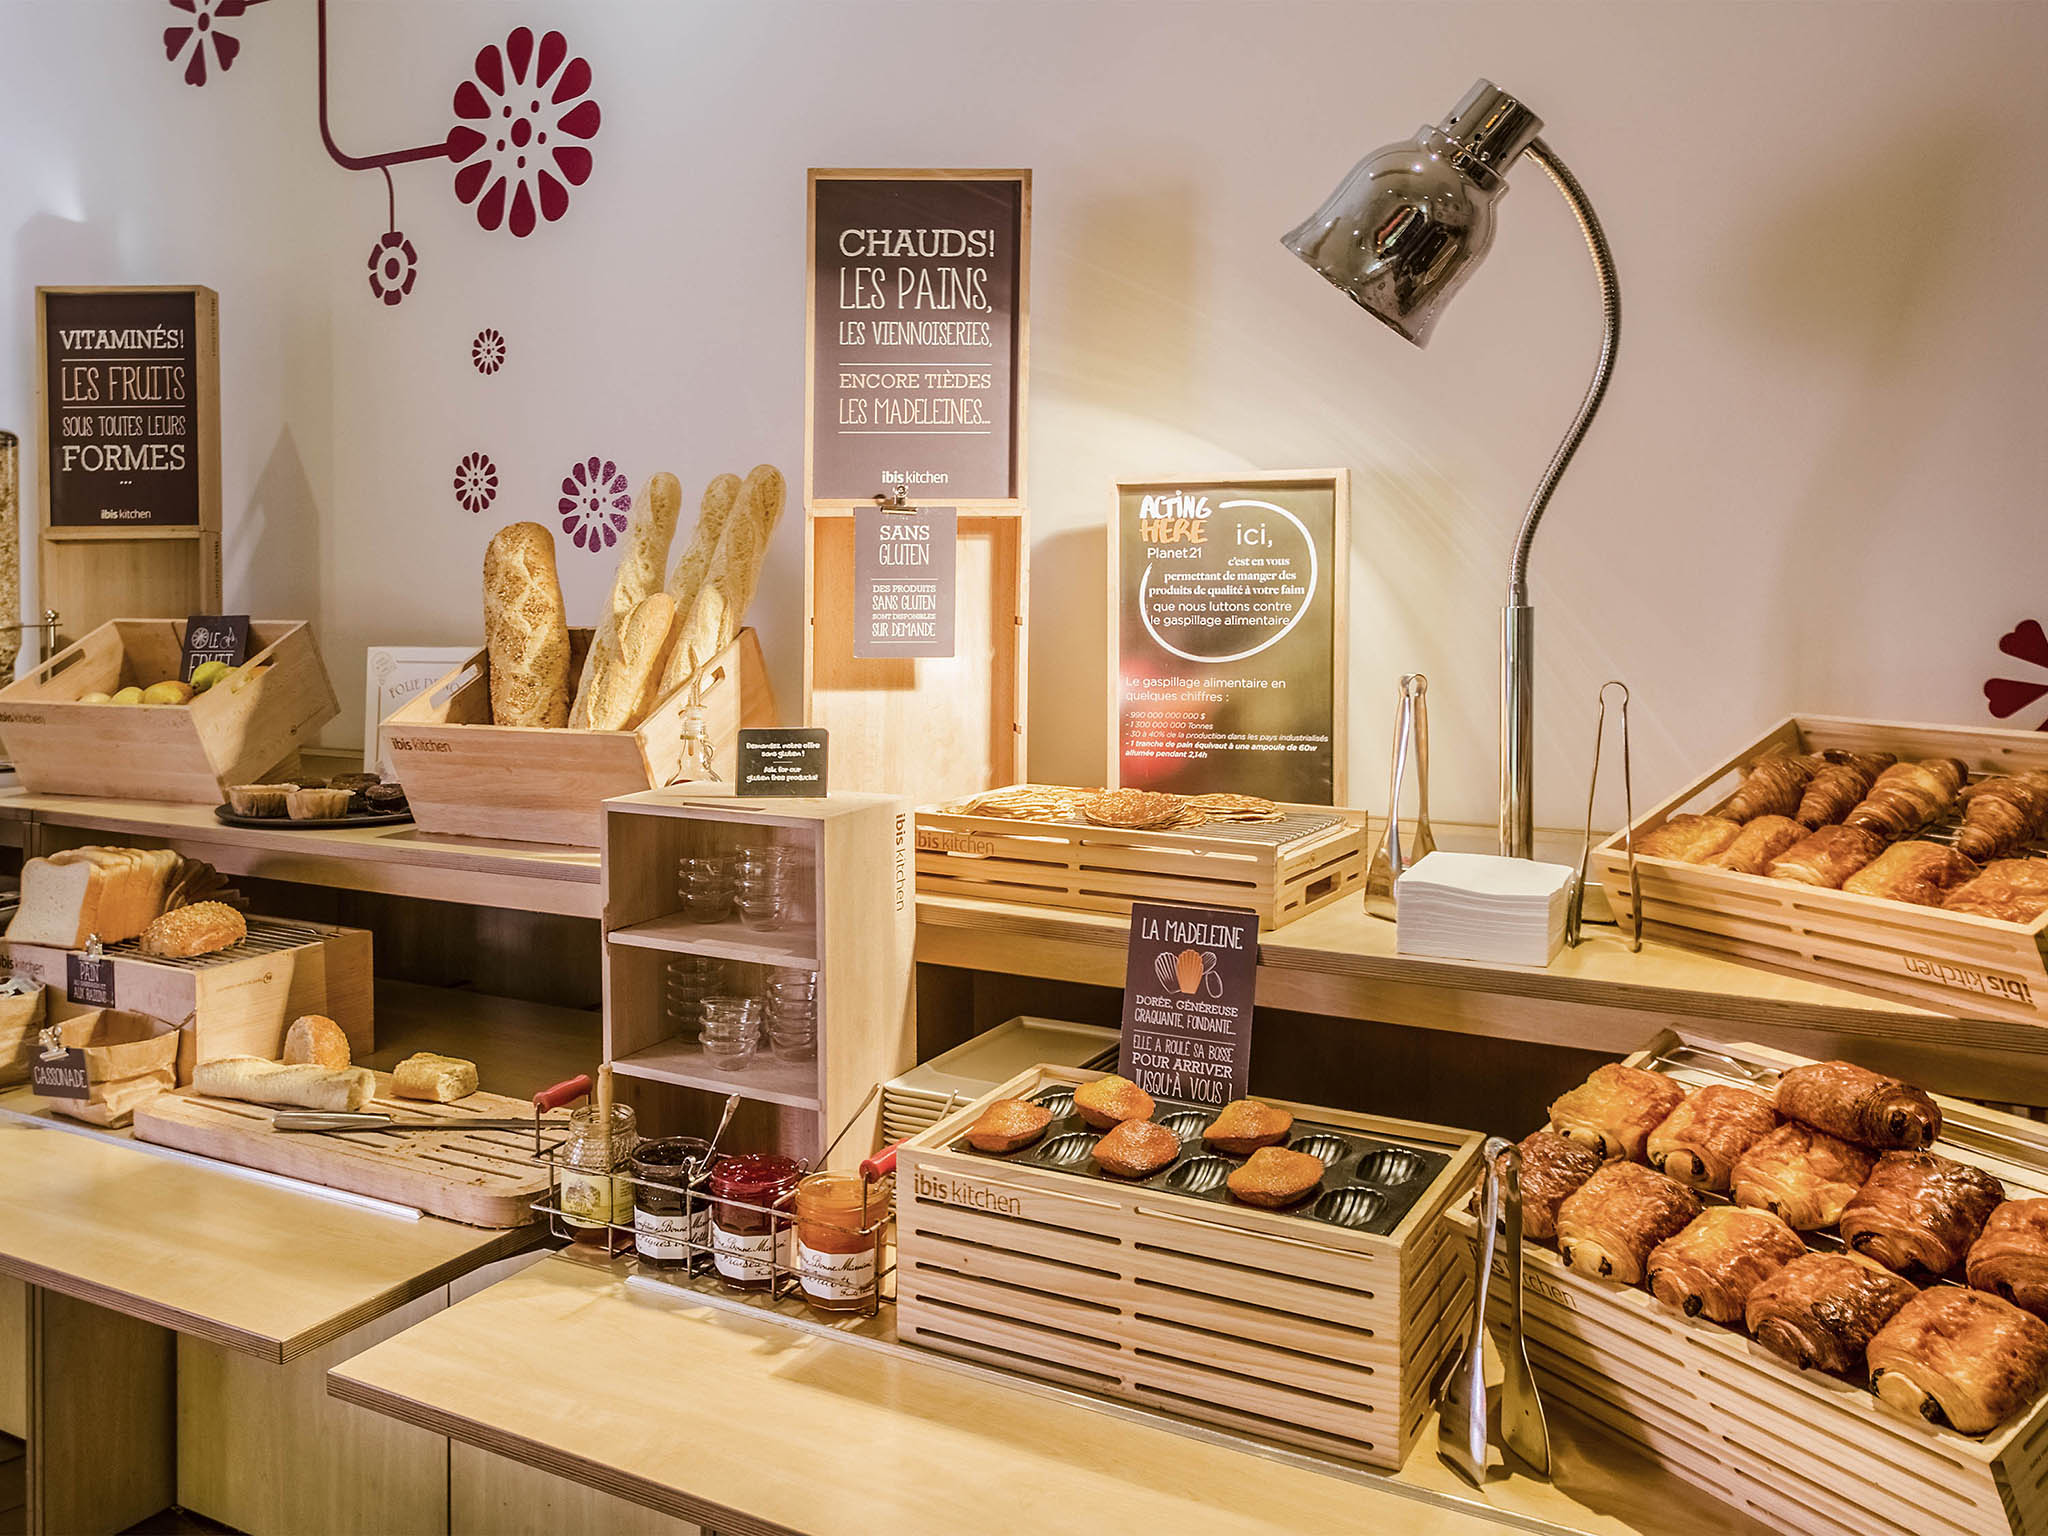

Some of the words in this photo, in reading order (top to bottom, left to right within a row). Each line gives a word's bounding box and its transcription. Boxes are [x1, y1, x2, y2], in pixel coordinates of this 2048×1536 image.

[839, 229, 995, 257] CHAUDS!
[840, 267, 885, 310] LES
[898, 266, 993, 313] PAINS,
[59, 324, 185, 349] VITAMINÉS!
[840, 321, 865, 345] LES
[871, 321, 992, 348] VIENNOISERIES,
[62, 367, 99, 401] LES
[108, 366, 186, 400] FRUITS
[839, 373, 920, 389] ENCORE
[925, 369, 991, 389] TIÈDES
[839, 398, 867, 424] LES
[62, 416, 94, 437] SOUS
[98, 415, 143, 436] TOUTES
[148, 415, 186, 436] LEURS
[61, 444, 186, 472] FORMES
[882, 470, 904, 484] ibis
[905, 470, 948, 484] kitchen
[100, 509, 118, 520] ibis
[119, 509, 151, 519] kitchen
[880, 525, 930, 541] SANS
[1139, 518, 1209, 544] HERE
[1236, 523, 1273, 548] ici,
[879, 543, 930, 566] GLUTEN
[1251, 558, 1264, 567] en
[1164, 572, 1222, 584] permettant
[1222, 571, 1236, 581] de
[1237, 573, 1278, 584] manger
[1278, 570, 1297, 581] des
[872, 584, 891, 593] DES
[892, 584, 936, 593] PRODUITS
[1149, 586, 1193, 598] produits
[1193, 585, 1207, 595] de
[1208, 585, 1243, 598] qualité
[1244, 585, 1251, 595] à
[1252, 587, 1279, 595] votre
[1280, 584, 1305, 595] faim
[872, 595, 898, 610] SANS
[901, 595, 936, 611] GLUTEN
[1153, 603, 1175, 613] que
[1178, 604, 1206, 612] nous
[1209, 601, 1250, 612] luttons
[1253, 602, 1293, 612] contre
[871, 622, 888, 637] SUR
[891, 622, 936, 637] DEMANDE
[1150, 614, 1160, 625] le
[1163, 614, 1221, 627] gaspillage
[1224, 615, 1290, 626] alimentaire
[208, 632, 221, 648] LE
[1126, 677, 1140, 687] Le
[1143, 677, 1201, 689] gaspillage
[1203, 677, 1269, 689] alimentaire
[1271, 680, 1286, 689] en
[1126, 691, 1177, 702] quelques
[1181, 691, 1223, 702] chiffres
[1147, 711, 1163, 719] 000
[1183, 712, 1199, 720] 000
[1200, 712, 1206, 720] $
[1188, 722, 1214, 730] Tonnes
[391, 738, 413, 751] ibis
[413, 739, 453, 752] kitchen
[1136, 740, 1163, 748] tranche
[1165, 740, 1175, 748] de
[1176, 741, 1193, 749] pain
[1194, 742, 1227, 750] équivaut
[1228, 742, 1234, 750] à
[1251, 743, 1286, 751] ampoule
[1186, 732, 1226, 740] production
[1227, 733, 1246, 741] dans
[1247, 733, 1258, 741] les
[1259, 734, 1278, 742] pays
[1125, 749, 1155, 757] allumée
[1155, 750, 1187, 758] pendant
[895, 812, 906, 846] ibis
[918, 831, 939, 849] bis
[942, 832, 995, 855] kitchen
[896, 848, 906, 912] kitchen
[1142, 917, 1159, 941] LA
[1165, 919, 1245, 950] MADELEINE
[1904, 957, 1986, 993] kitchen
[1987, 975, 2033, 1004] ibis
[1135, 994, 1174, 1010] DORÉE,
[1176, 999, 1239, 1017] GÉNÉREUSE
[1135, 1007, 1185, 1029] CRAQUANTE,
[1133, 1034, 1152, 1050] ELLE
[1155, 1038, 1162, 1052] A
[1165, 1039, 1191, 1057] ROULÉ
[1193, 1043, 1205, 1059] SA
[1208, 1044, 1234, 1063] BOSSE
[34, 1065, 87, 1088] CASSONADE
[1132, 1052, 1170, 1069] POUR
[1173, 1057, 1233, 1079] ARRIVER
[1190, 1076, 1222, 1104] VOUS
[914, 1173, 948, 1199] ibis
[952, 1180, 1021, 1215] kitchen
